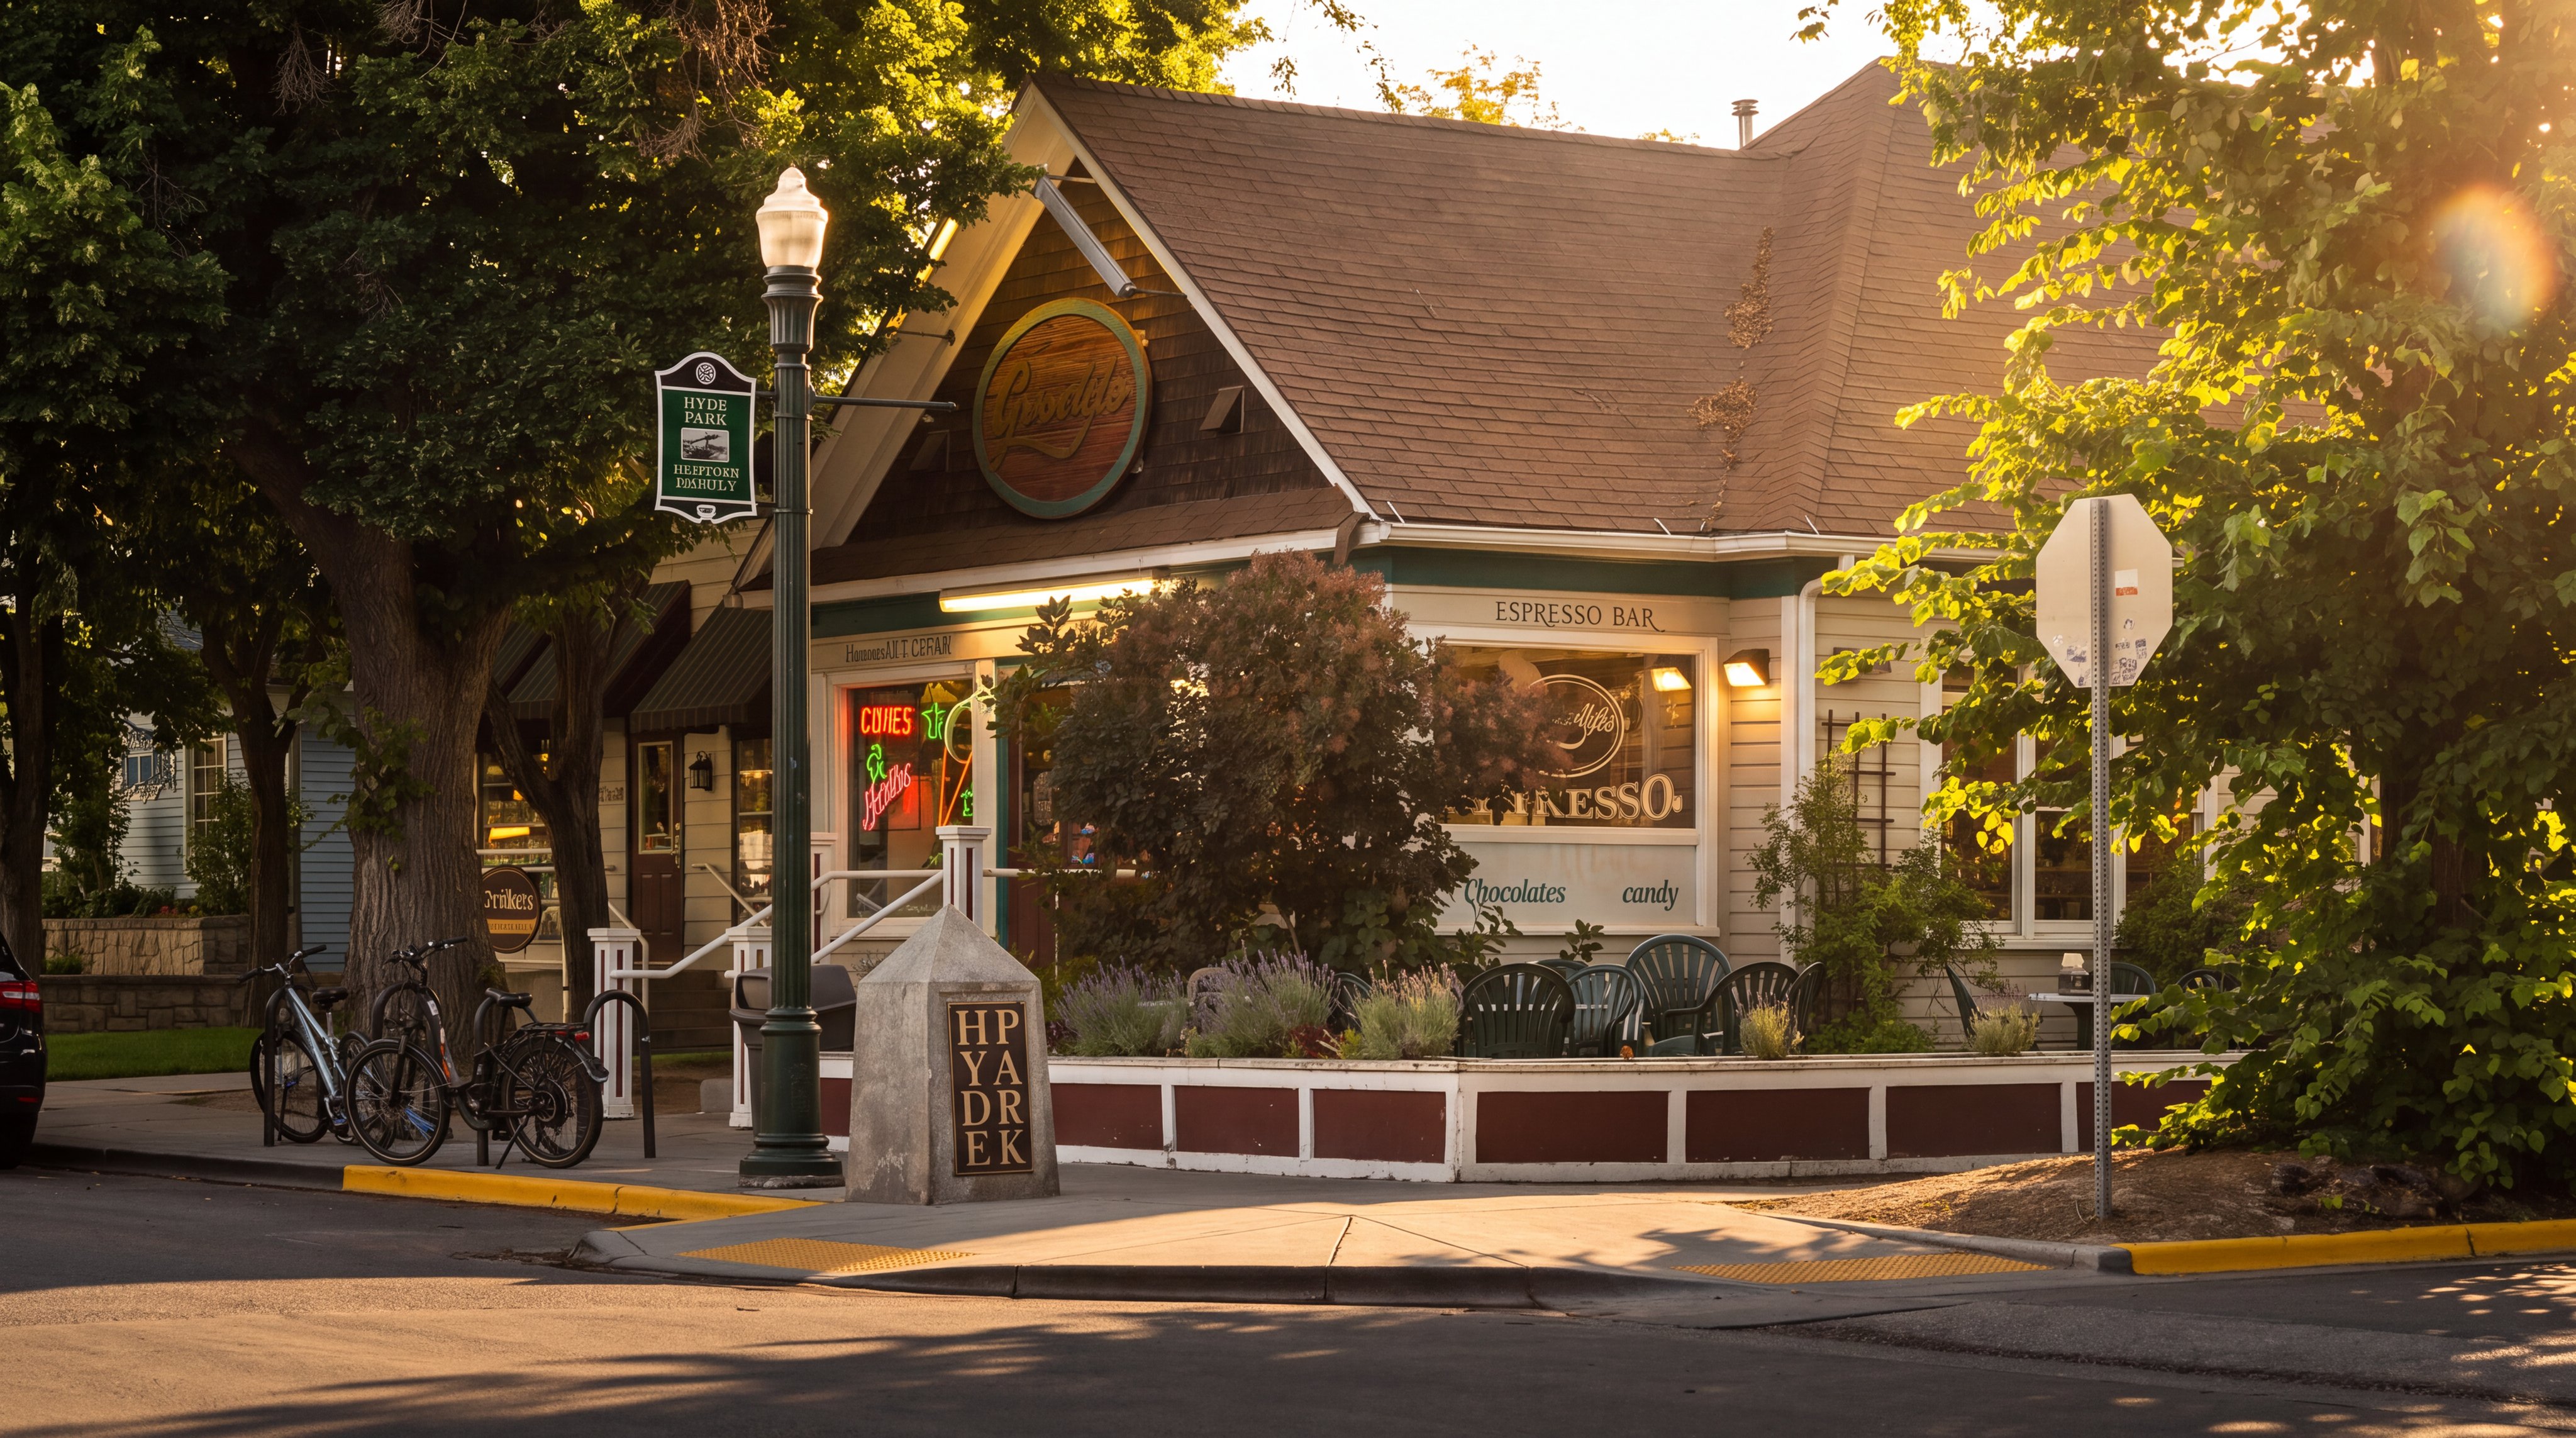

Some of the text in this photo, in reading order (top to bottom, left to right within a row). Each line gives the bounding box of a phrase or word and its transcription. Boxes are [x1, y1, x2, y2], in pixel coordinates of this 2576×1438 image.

[684, 396, 727, 411] HYDE
[684, 411, 727, 426] PARK
[1495, 601, 1666, 632] ESPRESSO BAR
[1464, 878, 1679, 911] Chocolates candy
